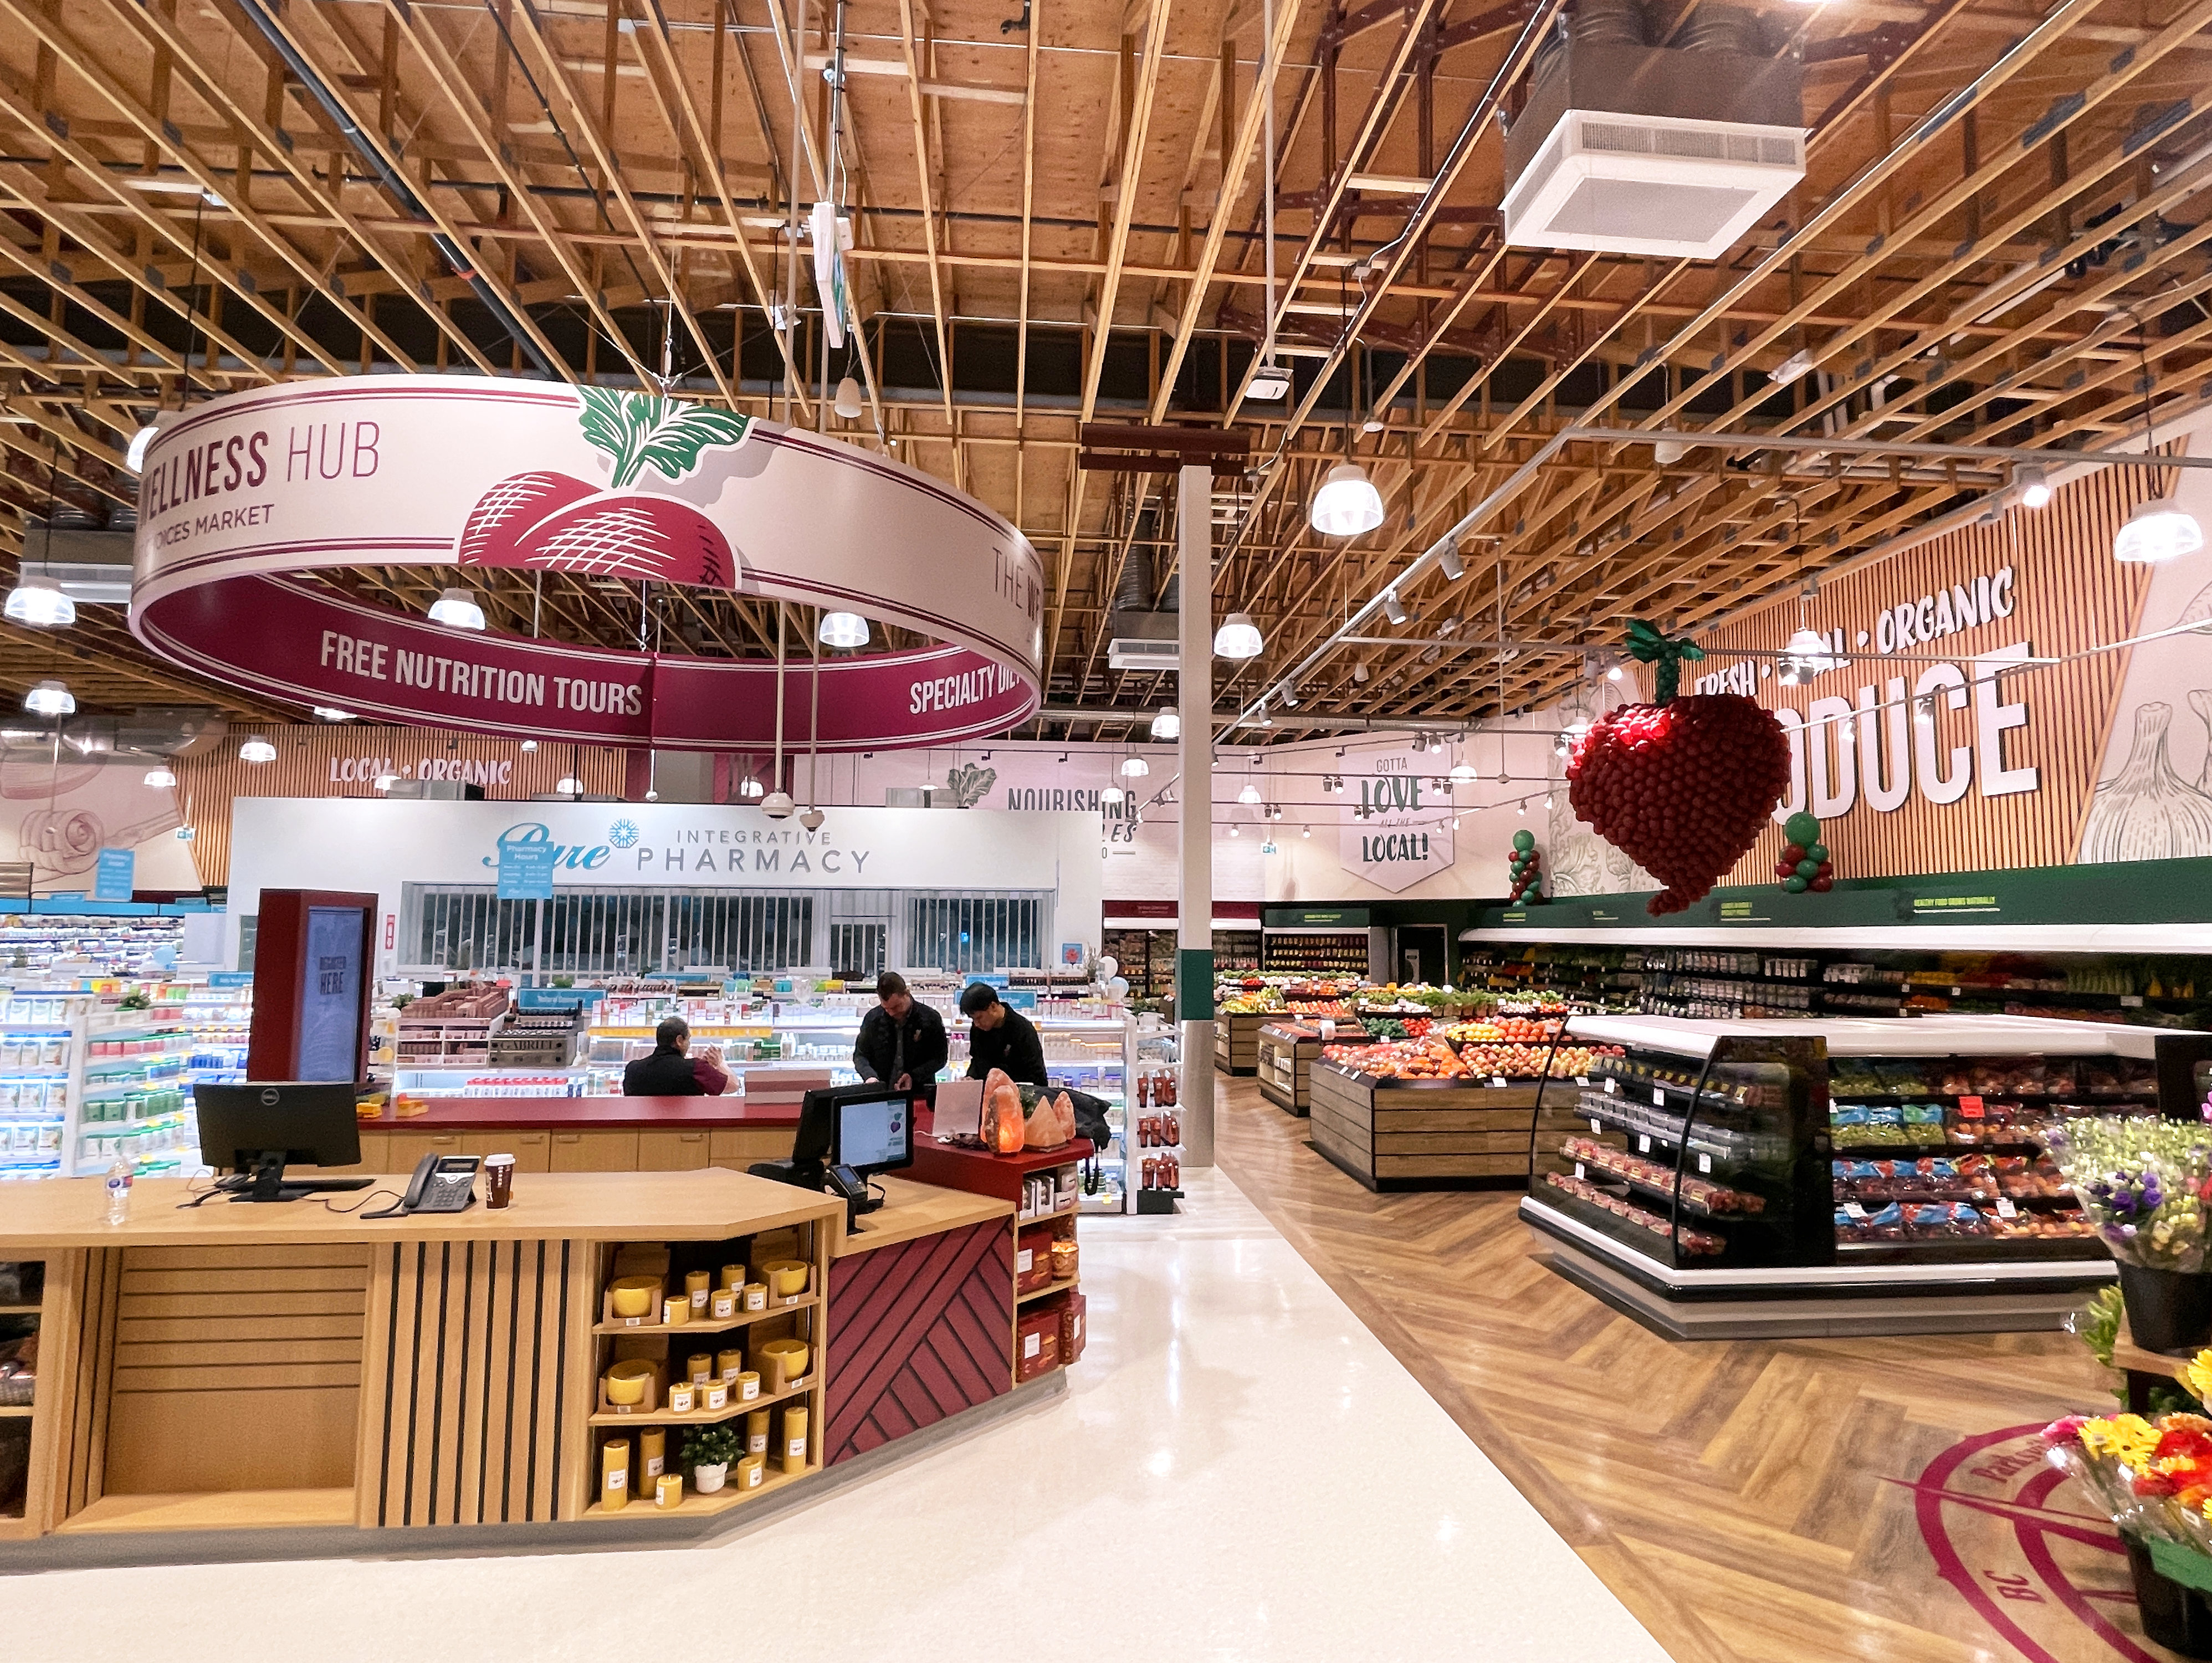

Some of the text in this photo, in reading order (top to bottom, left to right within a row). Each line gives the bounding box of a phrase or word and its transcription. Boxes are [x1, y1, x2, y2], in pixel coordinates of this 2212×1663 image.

[288, 422, 380, 482] HUB
[154, 503, 274, 549] OICES MARKET
[993, 546, 1023, 609] THE
[1877, 566, 2013, 654] ORGANIC
[321, 630, 642, 716] FREE NUTRITION TOURS
[910, 663, 996, 714] SPECIALTY
[1771, 642, 2037, 825] ODUCE
[330, 756, 512, 784] LOCAL ORGANIC
[1376, 757, 1408, 772] GOTTA
[1361, 776, 1424, 813] LOVE
[506, 845, 546, 853] Pharmacy
[677, 830, 831, 846] INTEGRATIVE
[1363, 833, 1428, 862] LOCAL!
[638, 847, 869, 874] PHARMACY
[1983, 1570, 2046, 1604] BC
